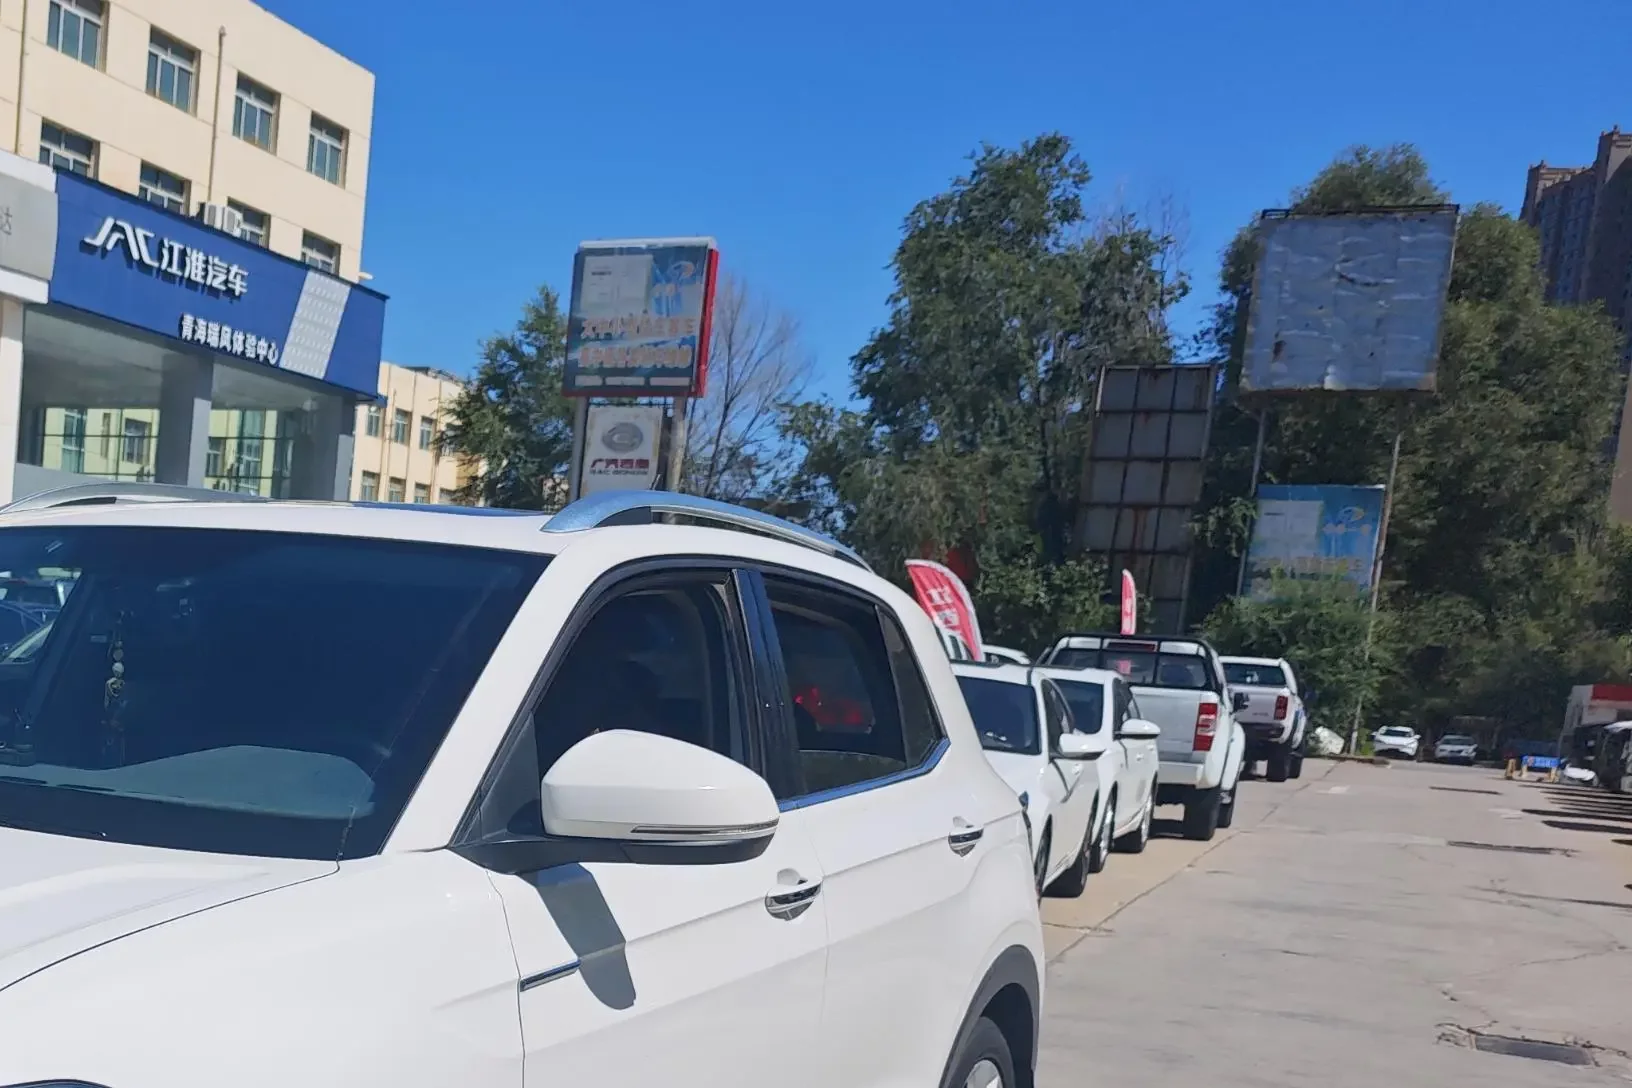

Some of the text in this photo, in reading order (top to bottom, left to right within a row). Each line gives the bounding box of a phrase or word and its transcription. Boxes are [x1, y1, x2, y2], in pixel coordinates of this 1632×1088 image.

[84, 216, 159, 268] JAC
[160, 238, 249, 296] 江淮汽车
[181, 313, 280, 365] 青海瑞风体验中心
